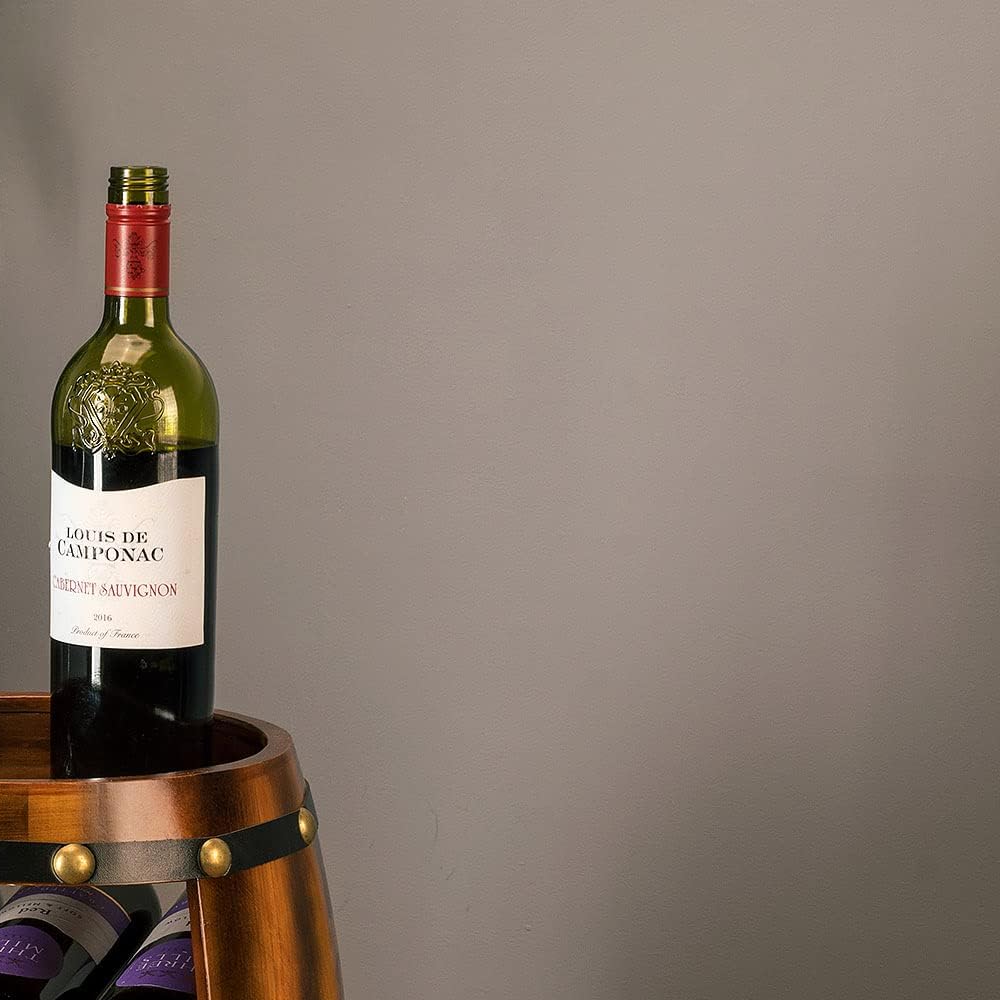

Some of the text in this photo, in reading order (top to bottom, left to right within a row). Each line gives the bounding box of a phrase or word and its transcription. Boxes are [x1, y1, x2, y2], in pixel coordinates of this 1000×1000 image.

[66, 526, 148, 543] LOUIS DE
[57, 538, 164, 562] CAMPONAC
[52, 575, 178, 598] CABERNET SAUVIGNON
[93, 613, 113, 622] 2016
[70, 625, 141, 640] Product of France
[18, 907, 50, 917] Red
[142, 952, 192, 963] ILLS
[135, 959, 196, 973] HREE
